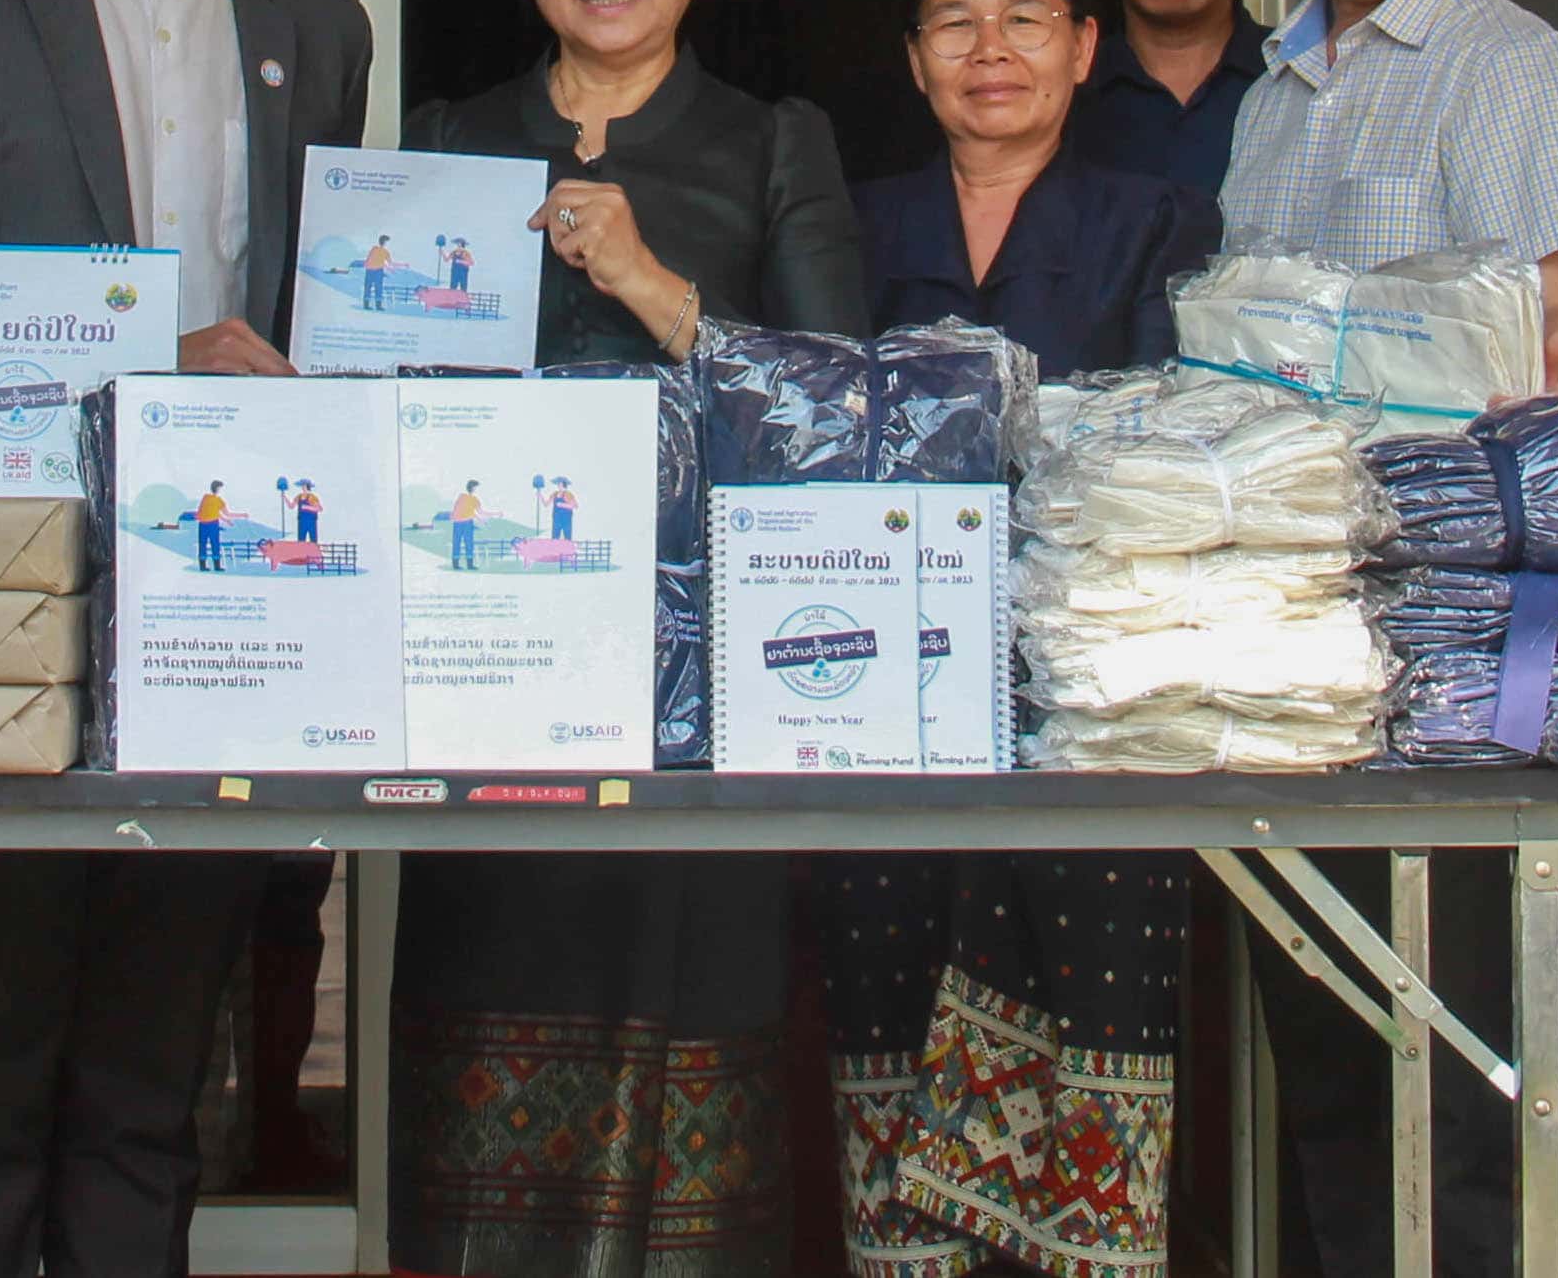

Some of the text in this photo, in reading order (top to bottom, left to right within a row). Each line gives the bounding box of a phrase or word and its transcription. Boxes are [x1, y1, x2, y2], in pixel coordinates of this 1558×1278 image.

[778, 714, 865, 727] Happy New Year
[326, 728, 376, 742] USAID
[573, 724, 623, 737] USAID
[856, 757, 914, 767] Fleming Fund
[930, 756, 988, 765] Fleming Fund
[373, 783, 438, 799] TMCL
